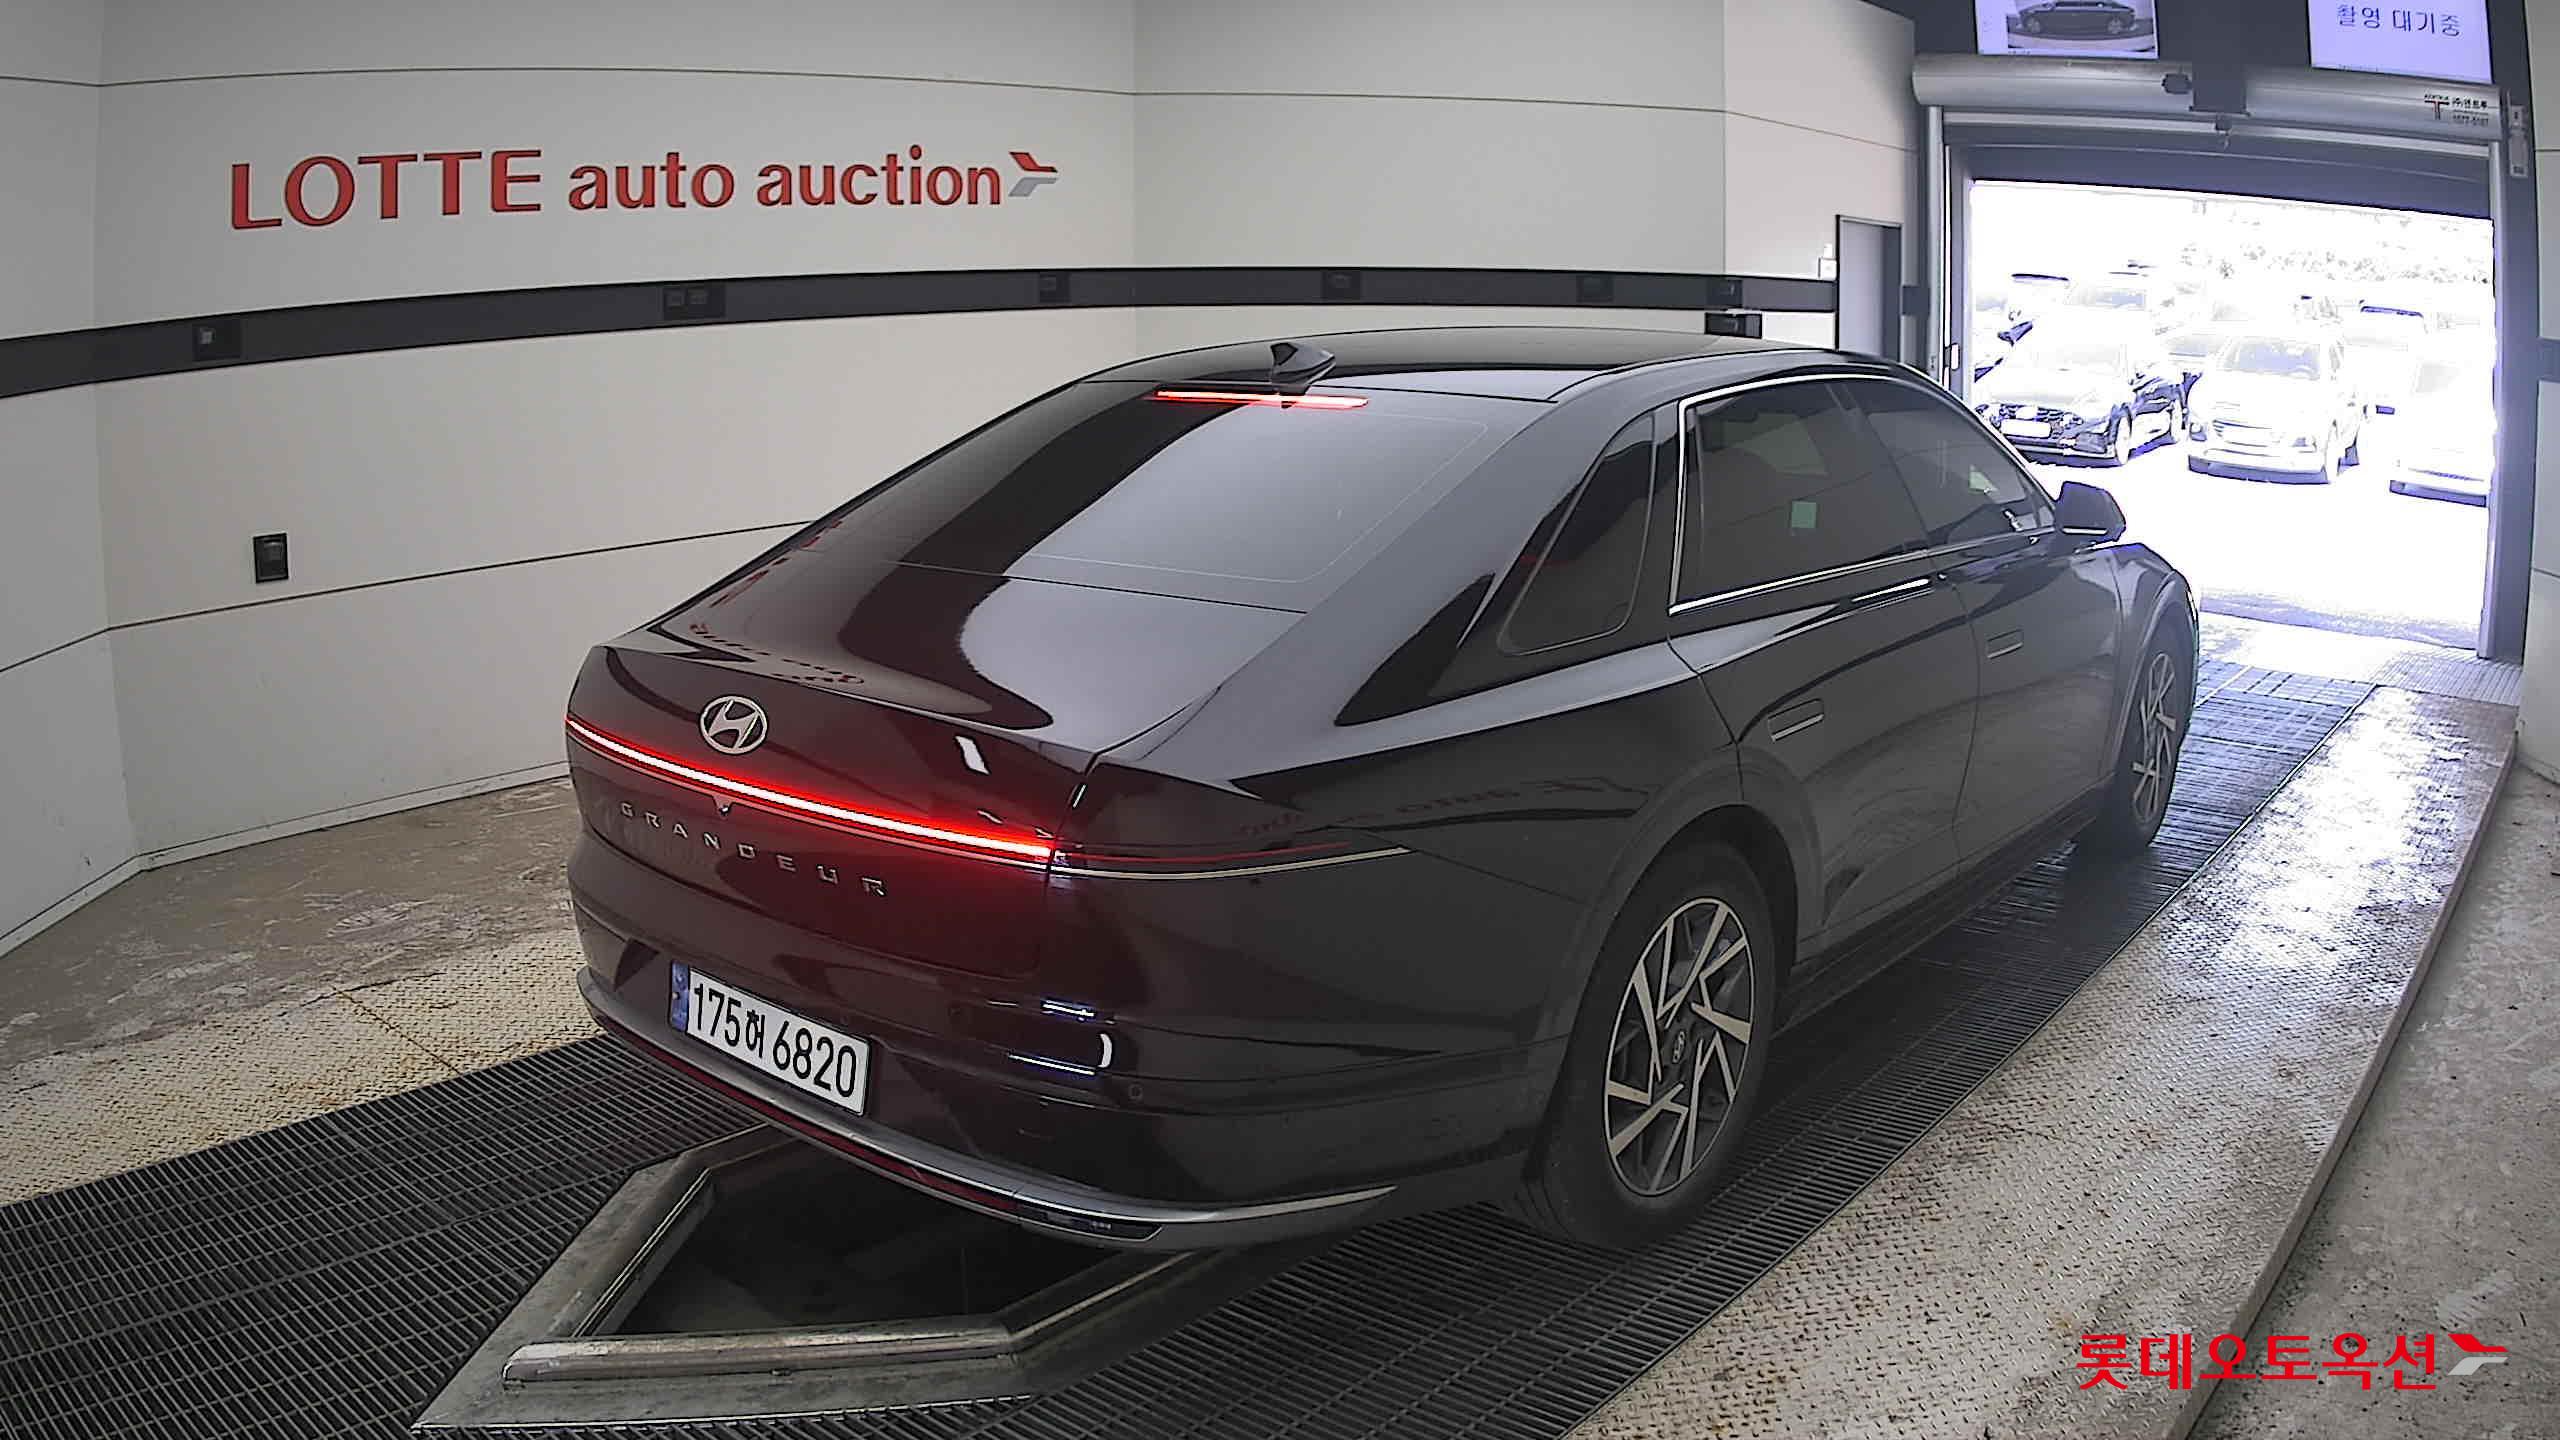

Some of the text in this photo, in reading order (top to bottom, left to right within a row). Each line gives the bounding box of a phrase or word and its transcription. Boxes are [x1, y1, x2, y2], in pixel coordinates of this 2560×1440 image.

[2337, 4, 2381, 29] 촬영
[232, 145, 1002, 229] LOTTE auto auction
[620, 801, 886, 897] GRANDEUR
[693, 982, 857, 1098] 175허 6820
